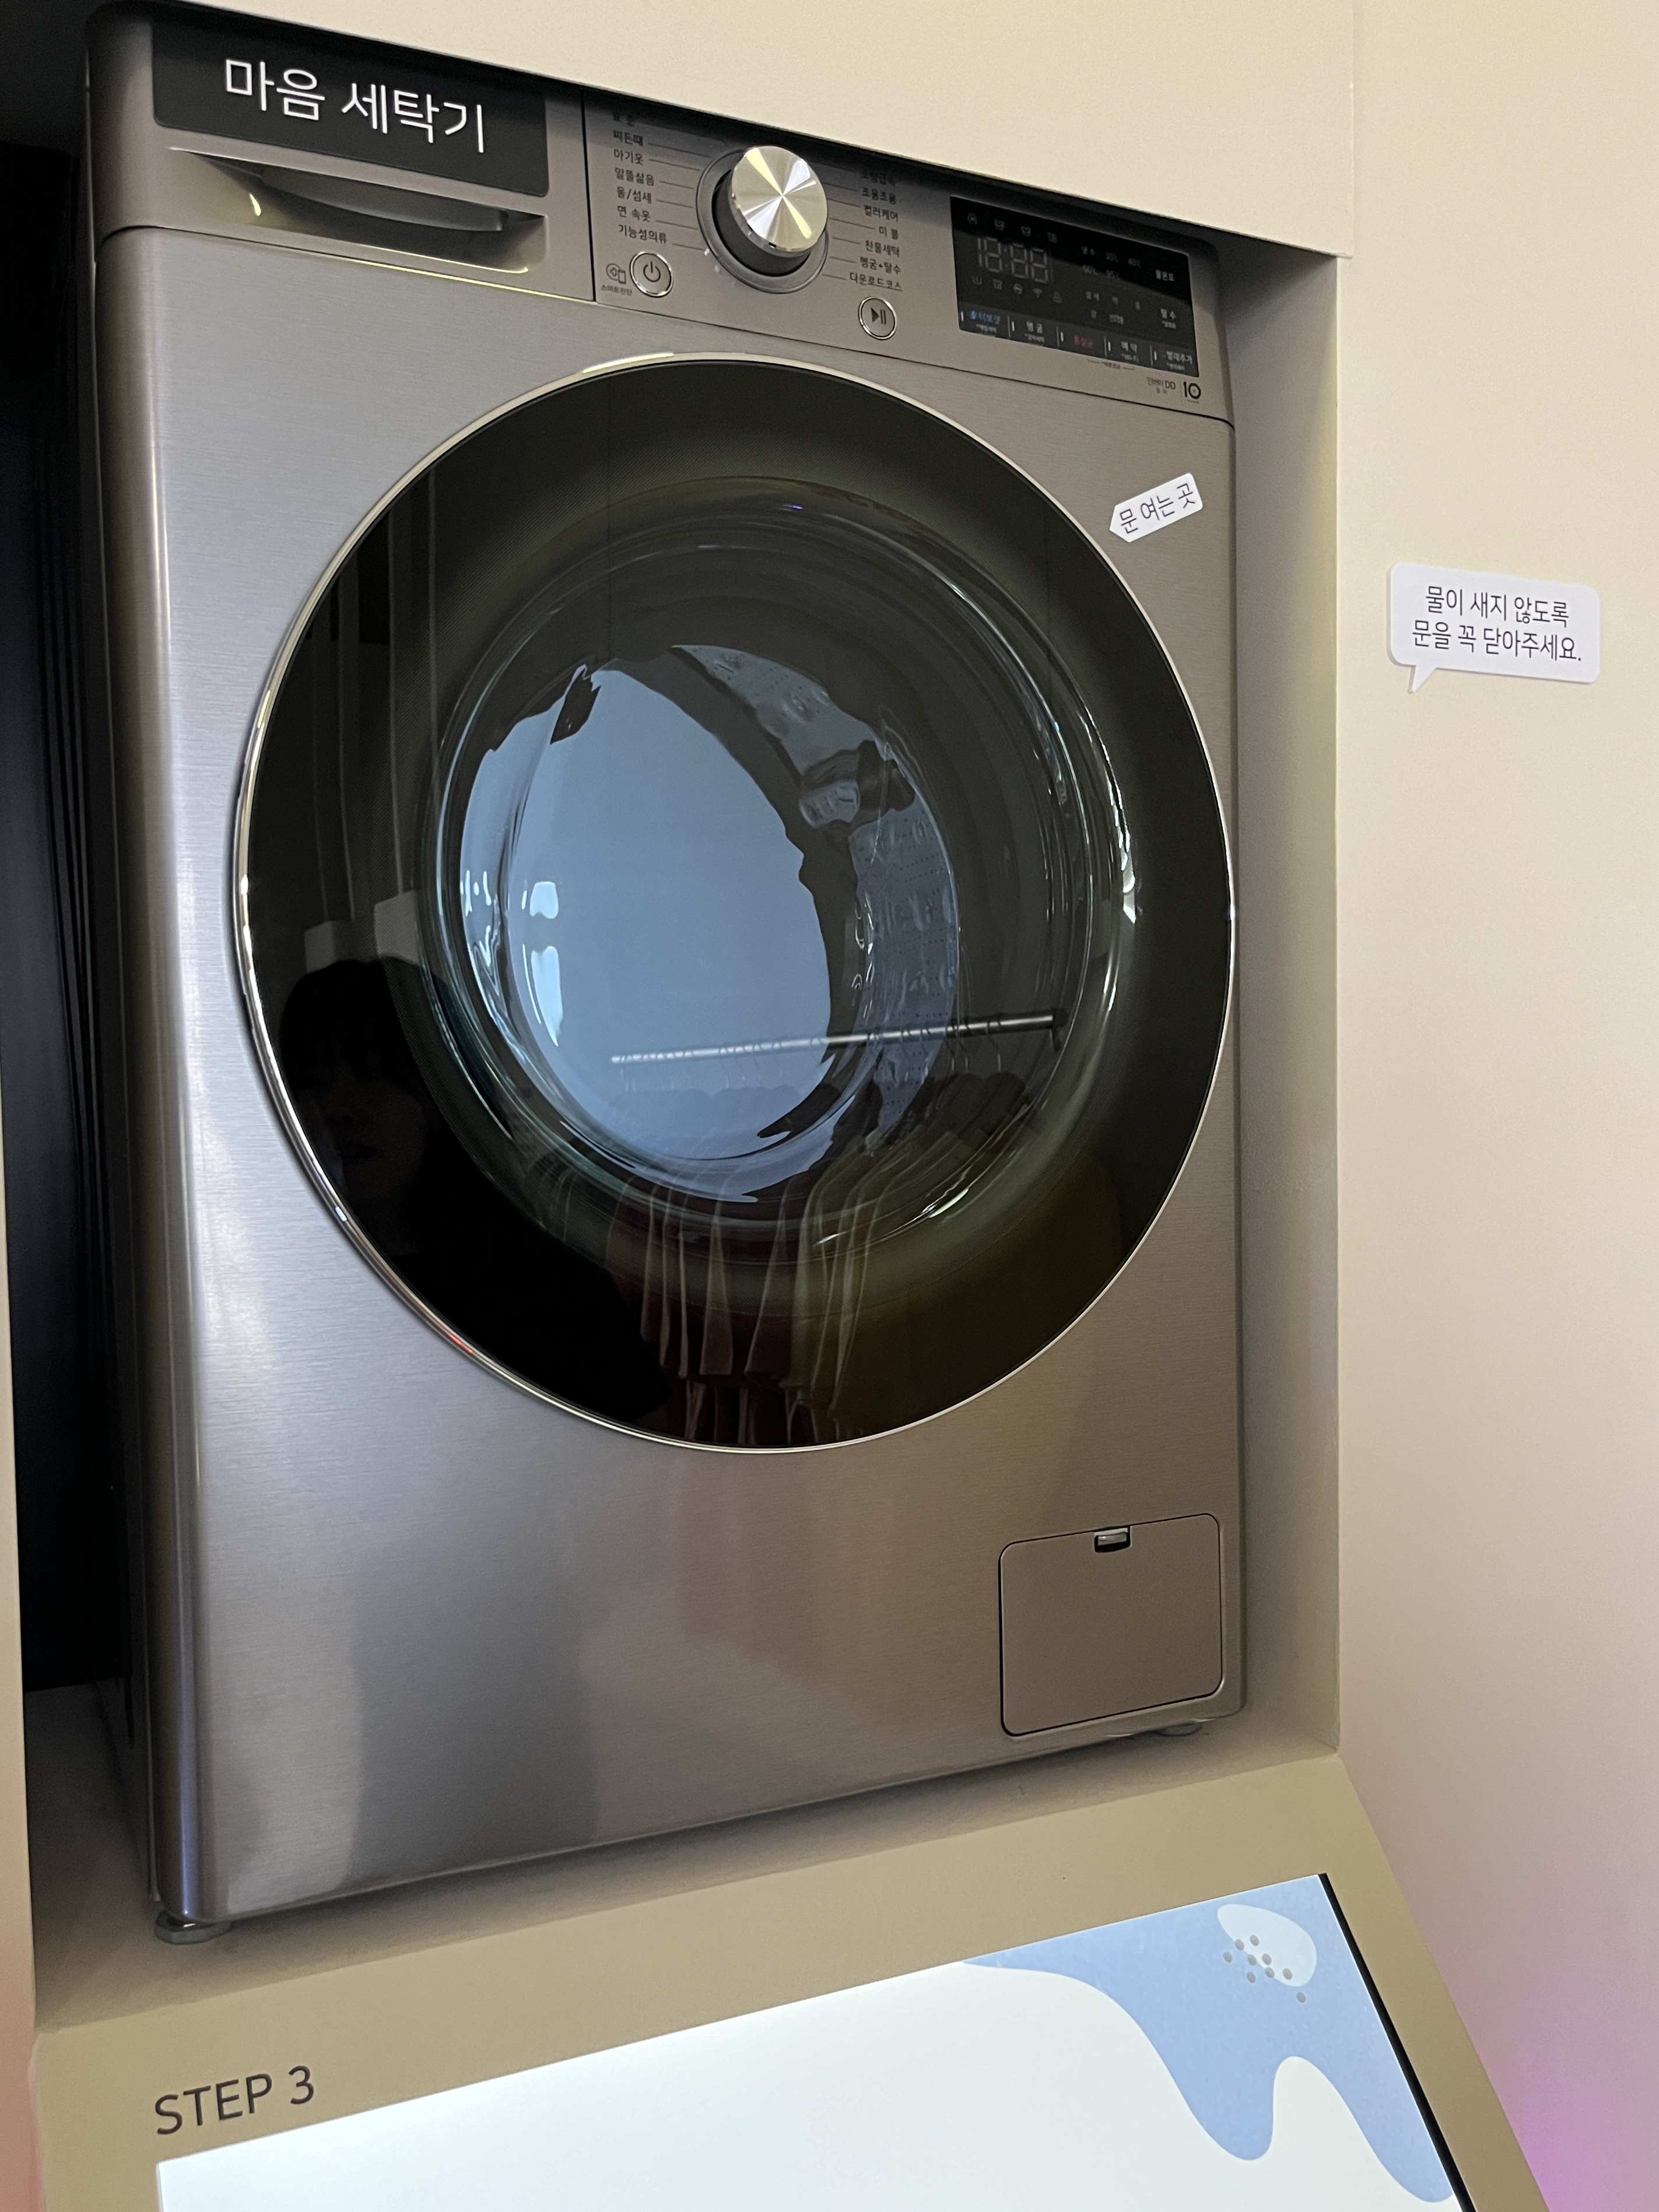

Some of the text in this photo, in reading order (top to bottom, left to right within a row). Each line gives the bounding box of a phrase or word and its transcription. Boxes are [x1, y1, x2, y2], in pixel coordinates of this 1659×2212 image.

[225, 58, 485, 154] 마음 세탁기
[613, 130, 643, 146] 찌든때
[613, 149, 643, 165] 아기옷
[615, 167, 654, 186] 알뜰삶음
[616, 186, 651, 204] 울/섬세
[862, 187, 896, 205] 조용조용
[617, 205, 650, 222] 면 속옷
[864, 205, 898, 222] 컬러케어
[618, 224, 667, 244] 기능성의류
[865, 240, 900, 258] 찬물세탁
[850, 272, 902, 290] 다운로드코스
[1120, 483, 1195, 534] 문 여는 곳
[1426, 586, 1569, 628] 물이 새지 않도록
[1412, 620, 1581, 661] 문을 꼭 닫아주세요.
[155, 2065, 315, 2135] STEP 3
